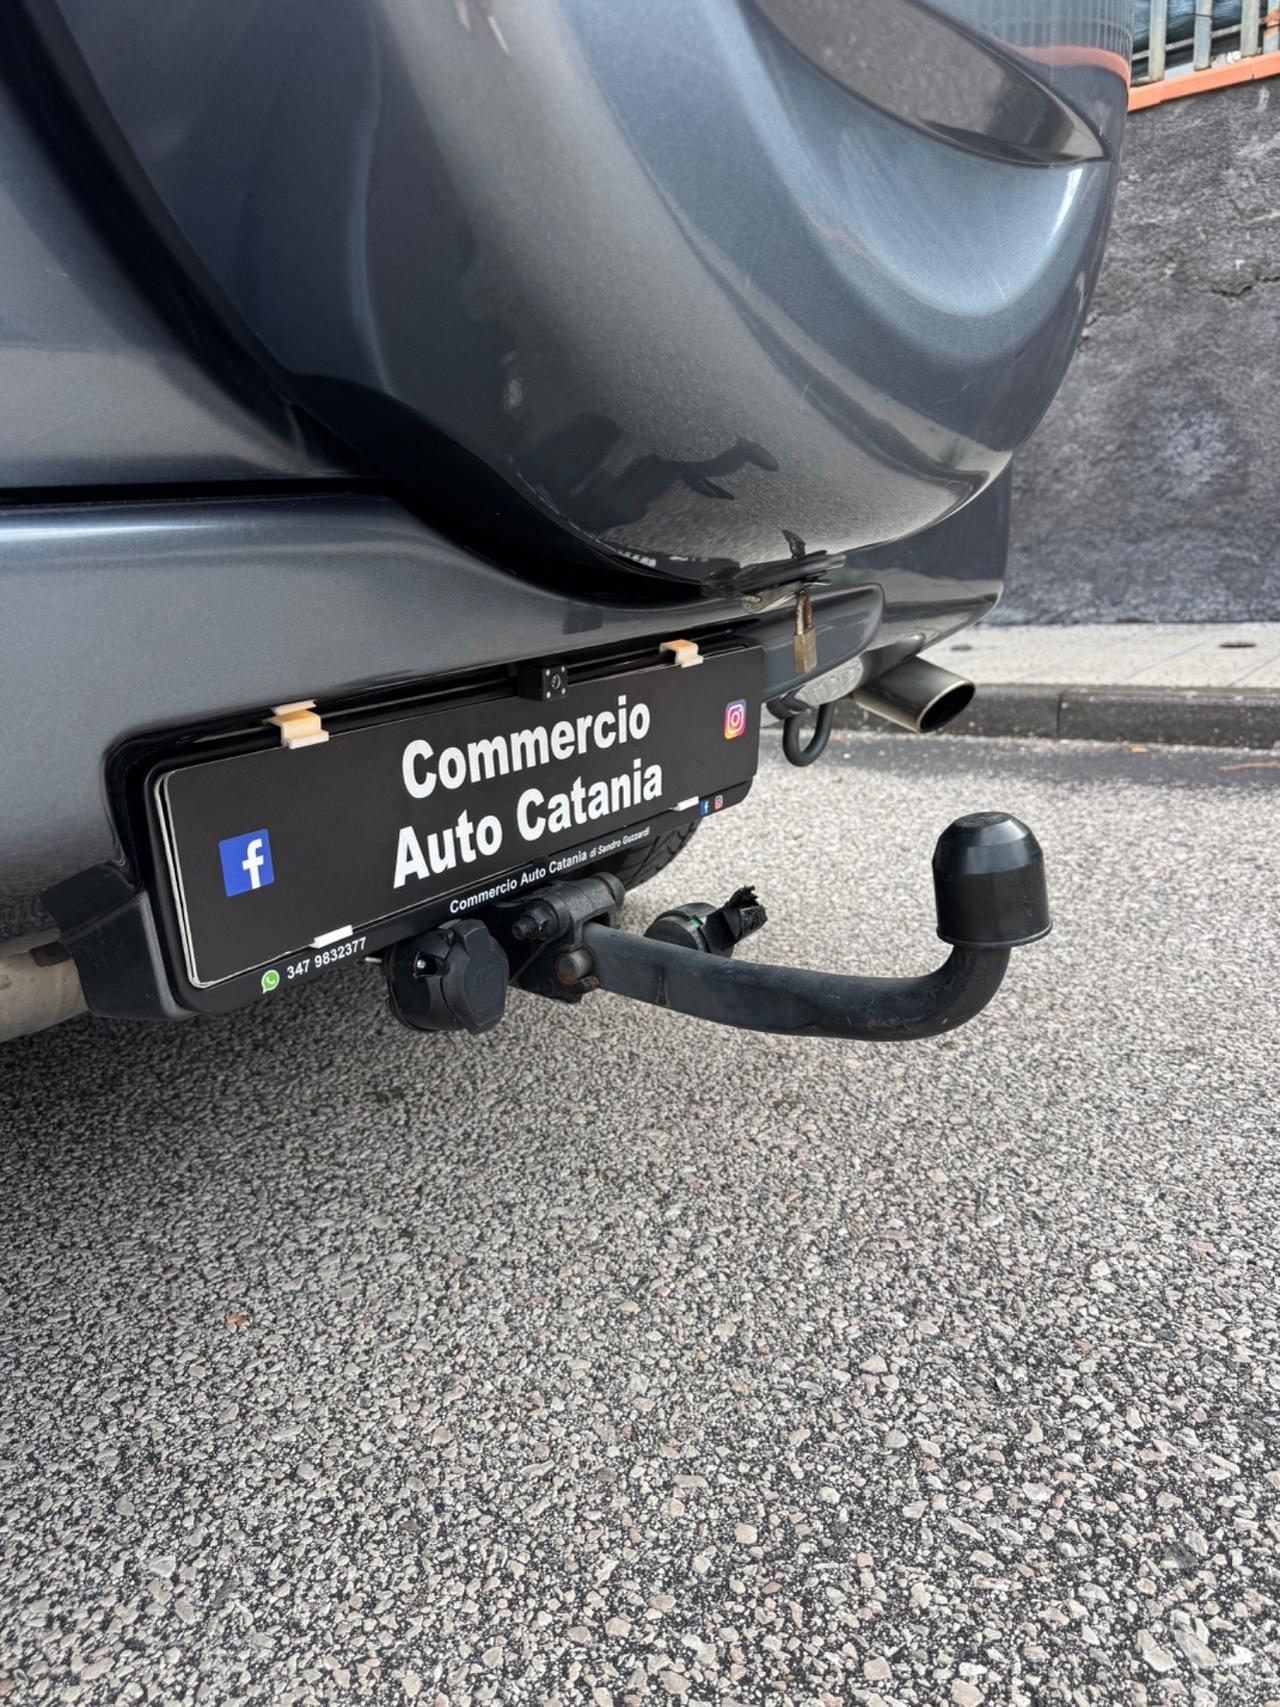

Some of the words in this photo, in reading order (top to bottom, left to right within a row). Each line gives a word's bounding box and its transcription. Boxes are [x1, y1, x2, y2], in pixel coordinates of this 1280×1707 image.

[402, 694, 651, 799] Commercio
[393, 809, 503, 889] Auto
[516, 757, 663, 842] Catania
[449, 879, 518, 914] Commercio
[520, 867, 546, 887] Auto
[549, 850, 588, 874] Catania
[589, 847, 597, 858] di
[597, 840, 622, 855] Sandro
[286, 958, 311, 979] 347
[314, 936, 367, 969] 9832377
